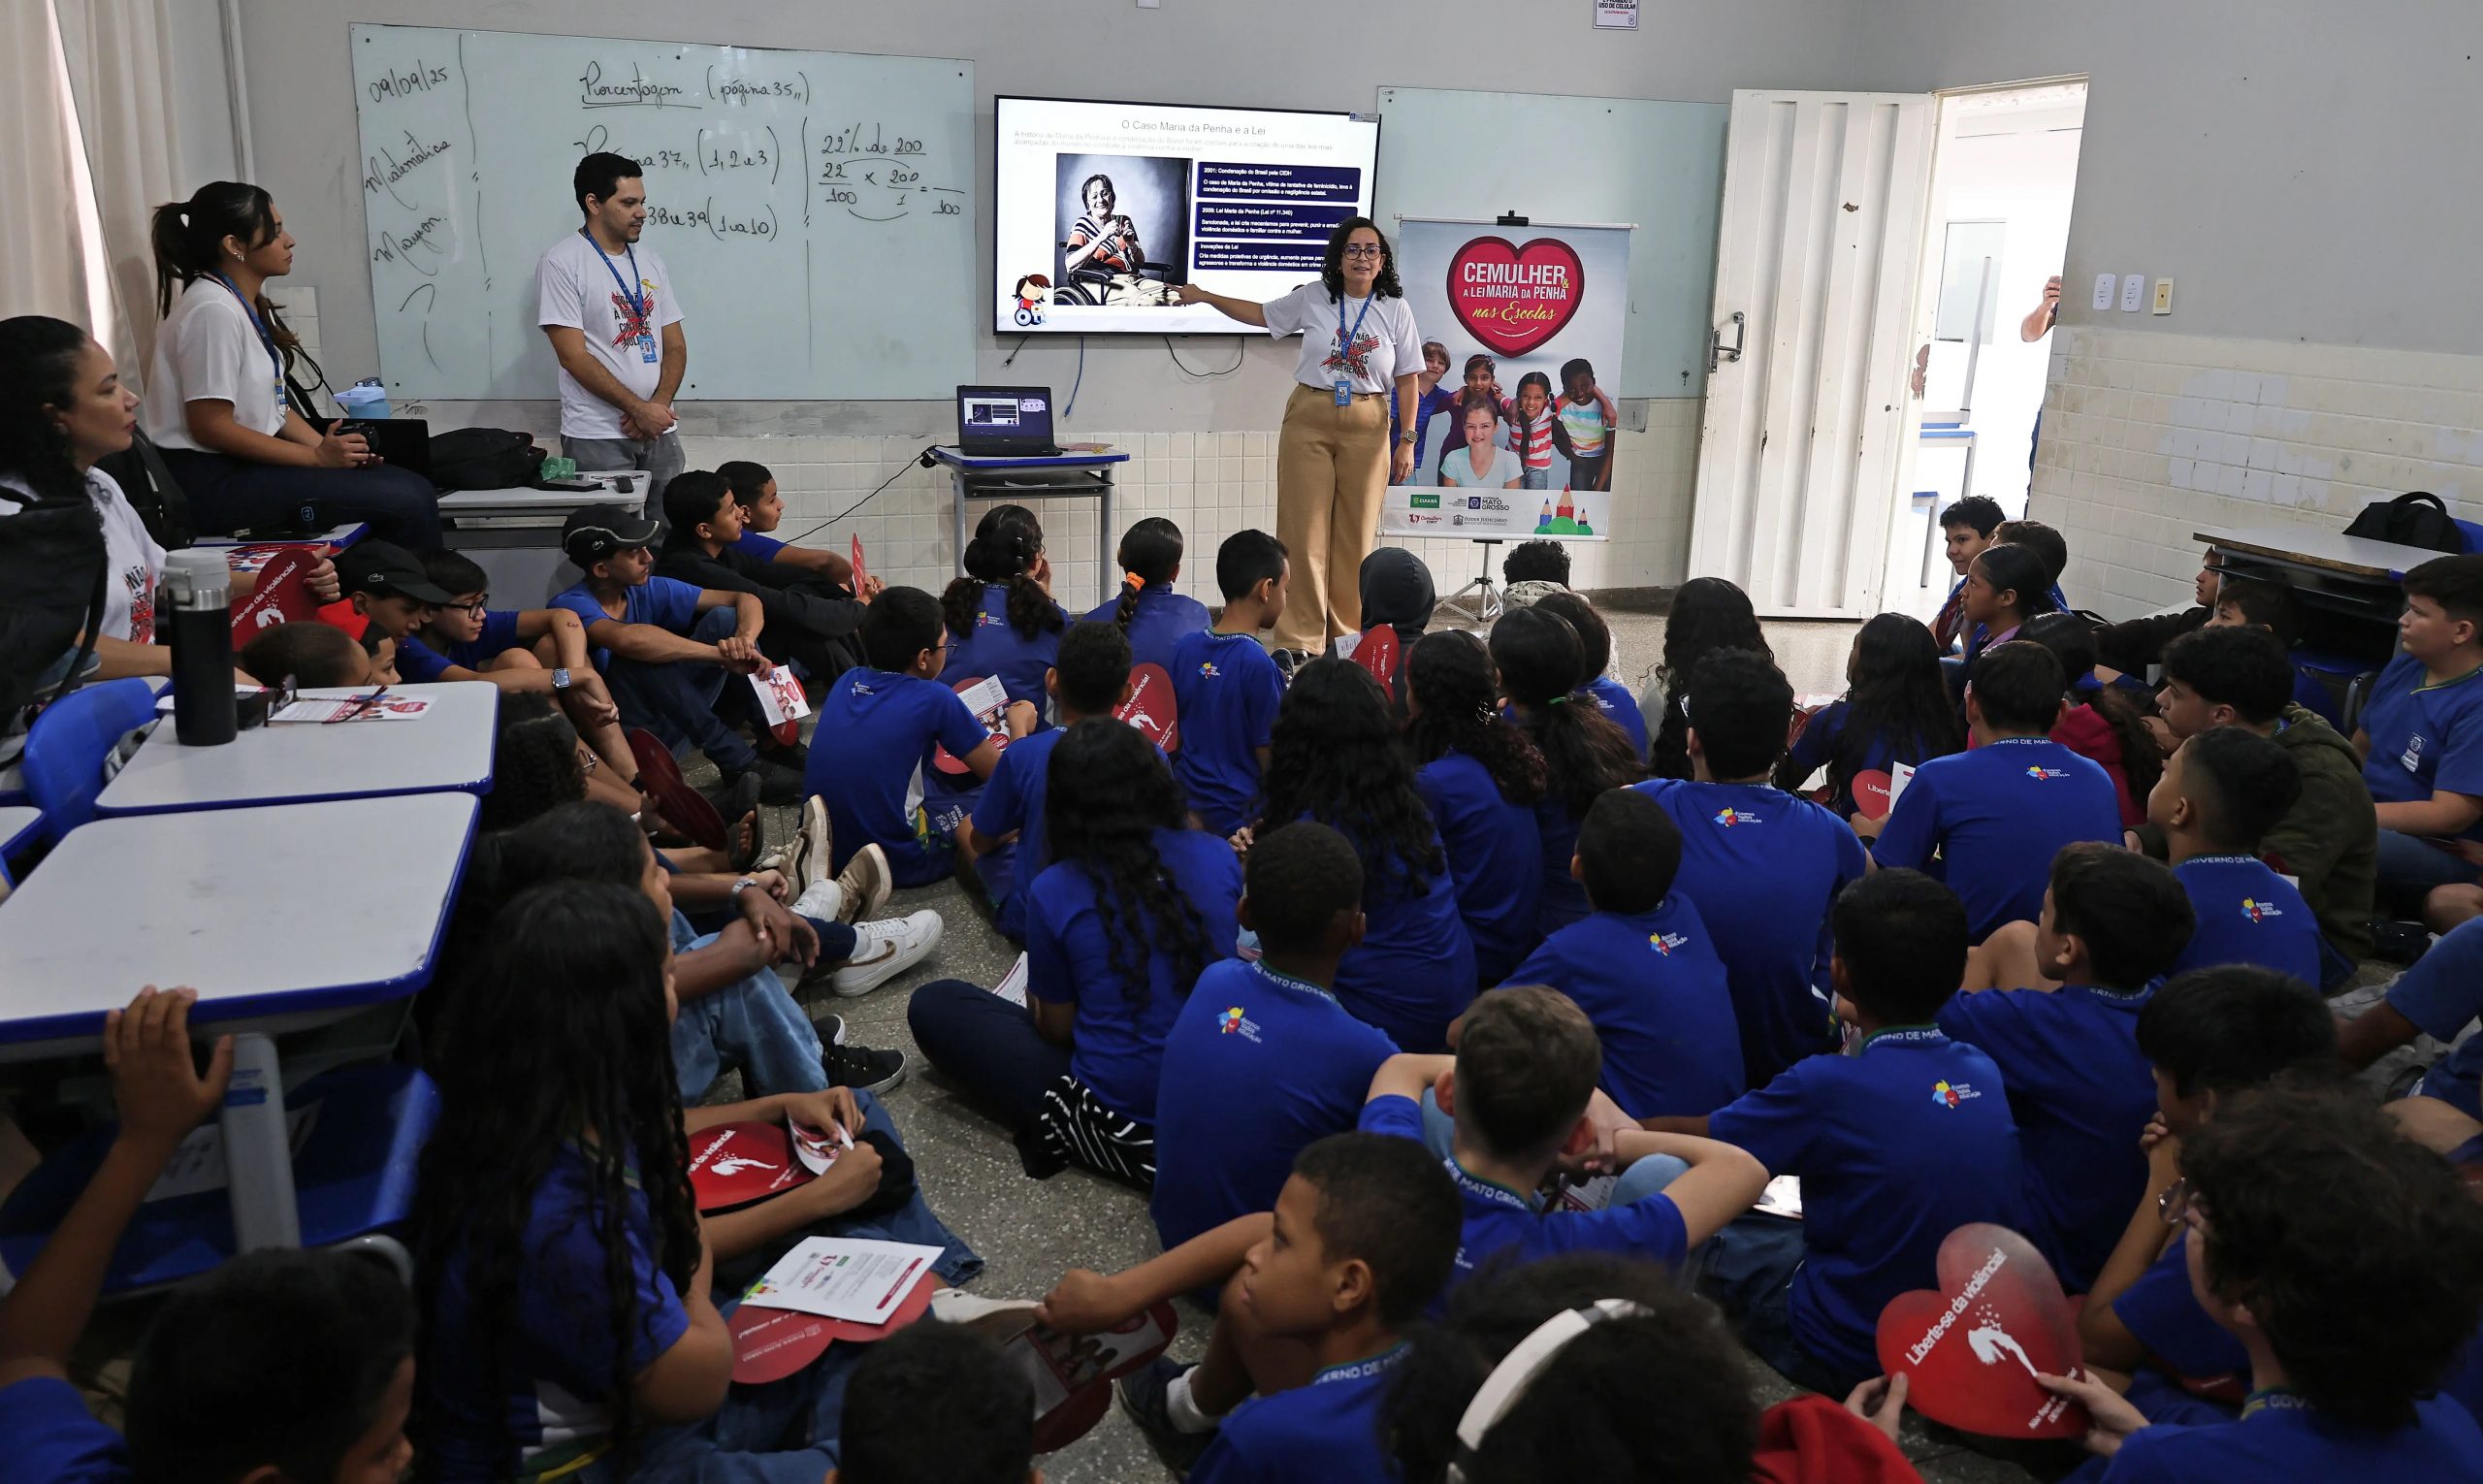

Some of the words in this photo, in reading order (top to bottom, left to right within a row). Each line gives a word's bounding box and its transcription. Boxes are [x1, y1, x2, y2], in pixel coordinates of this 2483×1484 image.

[369, 59, 448, 103] 09/09/25
[1121, 119, 1130, 129] O
[1133, 120, 1157, 131] Caso
[1160, 121, 1186, 132] Maria
[1189, 123, 1200, 133] da
[1204, 123, 1232, 134] Penha
[1252, 125, 1266, 135] Lei
[894, 137, 922, 153] 200
[822, 162, 848, 178] 22
[889, 169, 919, 184] 200
[825, 187, 857, 205] 100
[932, 199, 960, 215] 100
[1464, 262, 1565, 285] CEMULHER
[1562, 277, 1569, 289] &
[1463, 289, 1468, 298] A
[1470, 286, 1485, 298] LEI
[1486, 285, 1518, 299] MARIA
[1521, 289, 1531, 299] DA
[1533, 286, 1566, 300] PENHA
[1472, 306, 1499, 318] nas
[1501, 301, 1557, 325] Escolas
[1355, 332, 1370, 341] NÃO
[1262, 970, 1290, 987] MATO
[1906, 1031, 1920, 1041] DE
[1459, 1176, 1496, 1199] MATO
[1905, 1309, 1956, 1366] Liberte-se
[1951, 1295, 1969, 1315] da
[1962, 1246, 2008, 1300] violência!
